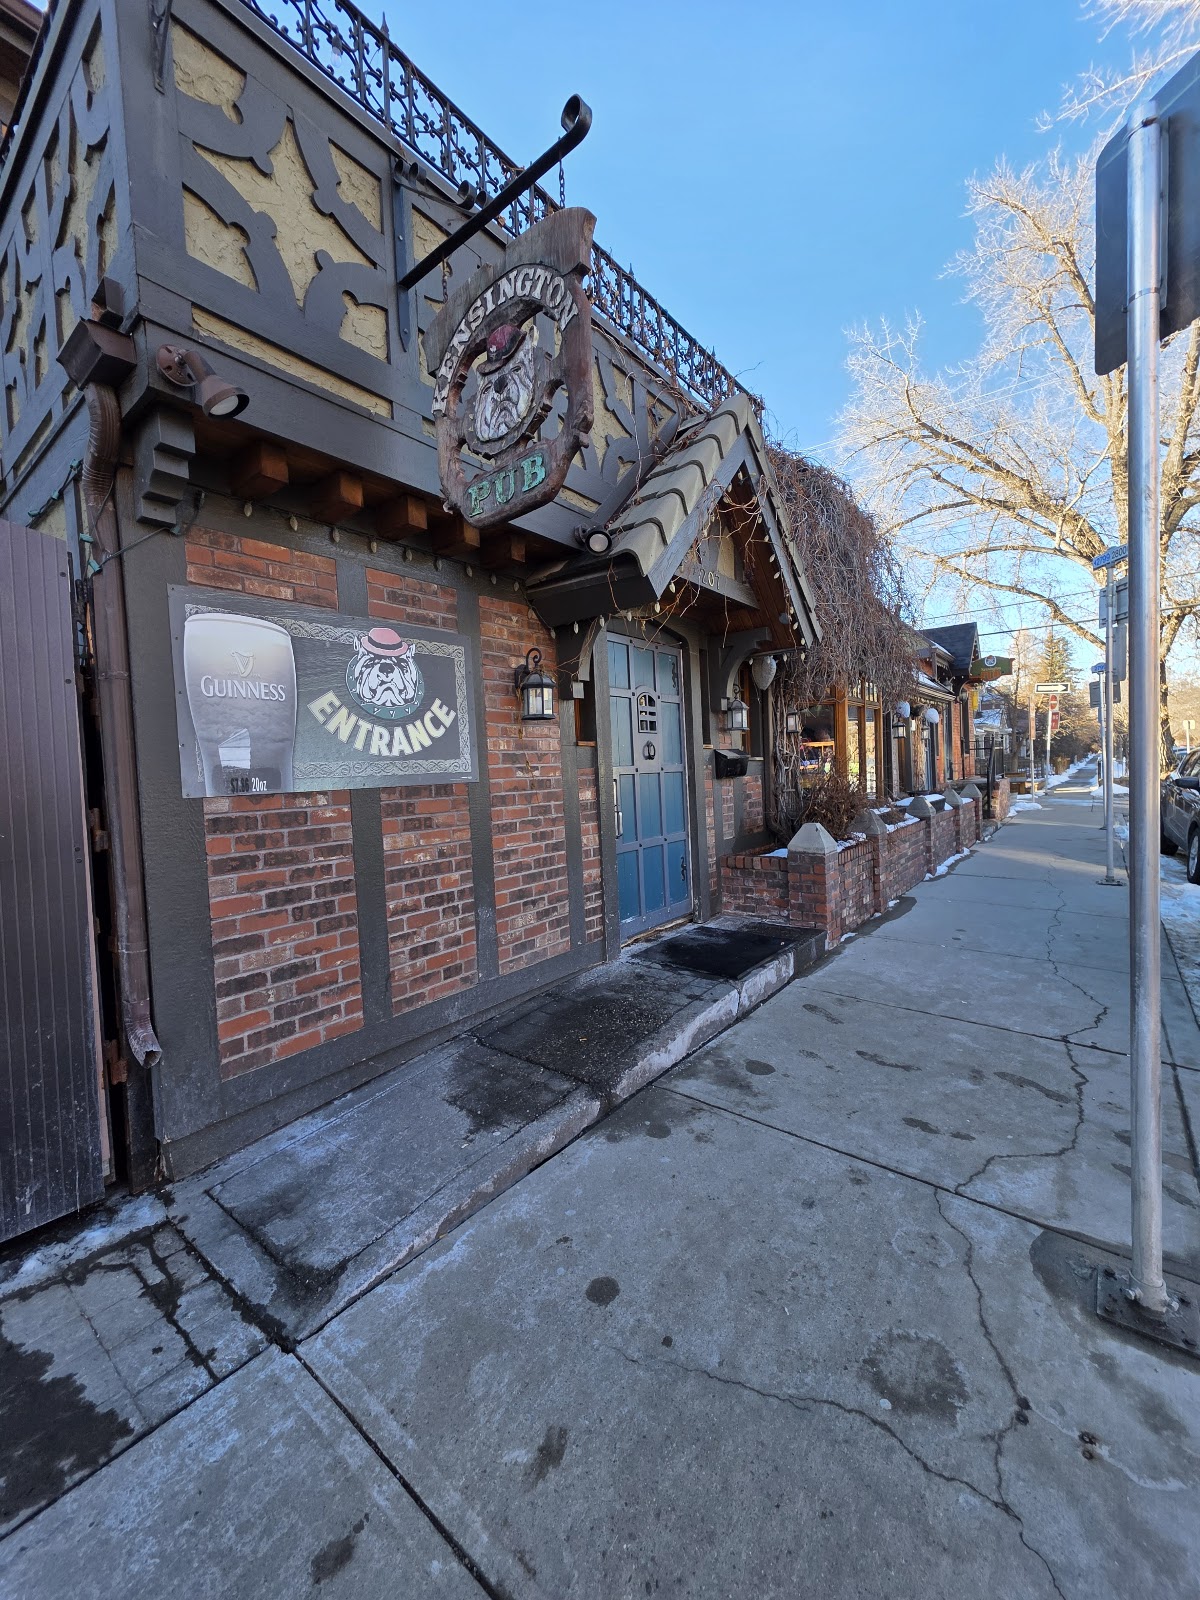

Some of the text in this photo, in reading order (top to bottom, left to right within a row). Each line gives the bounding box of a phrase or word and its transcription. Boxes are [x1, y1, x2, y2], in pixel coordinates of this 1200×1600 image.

[431, 267, 579, 414] KENSINGTON
[467, 452, 547, 518] PUB
[1111, 545, 1127, 560] 2800
[699, 568, 720, 590] 207
[200, 675, 286, 702] GUINNESS
[306, 690, 457, 757] ENTRANCE
[251, 777, 268, 792] 20oz
